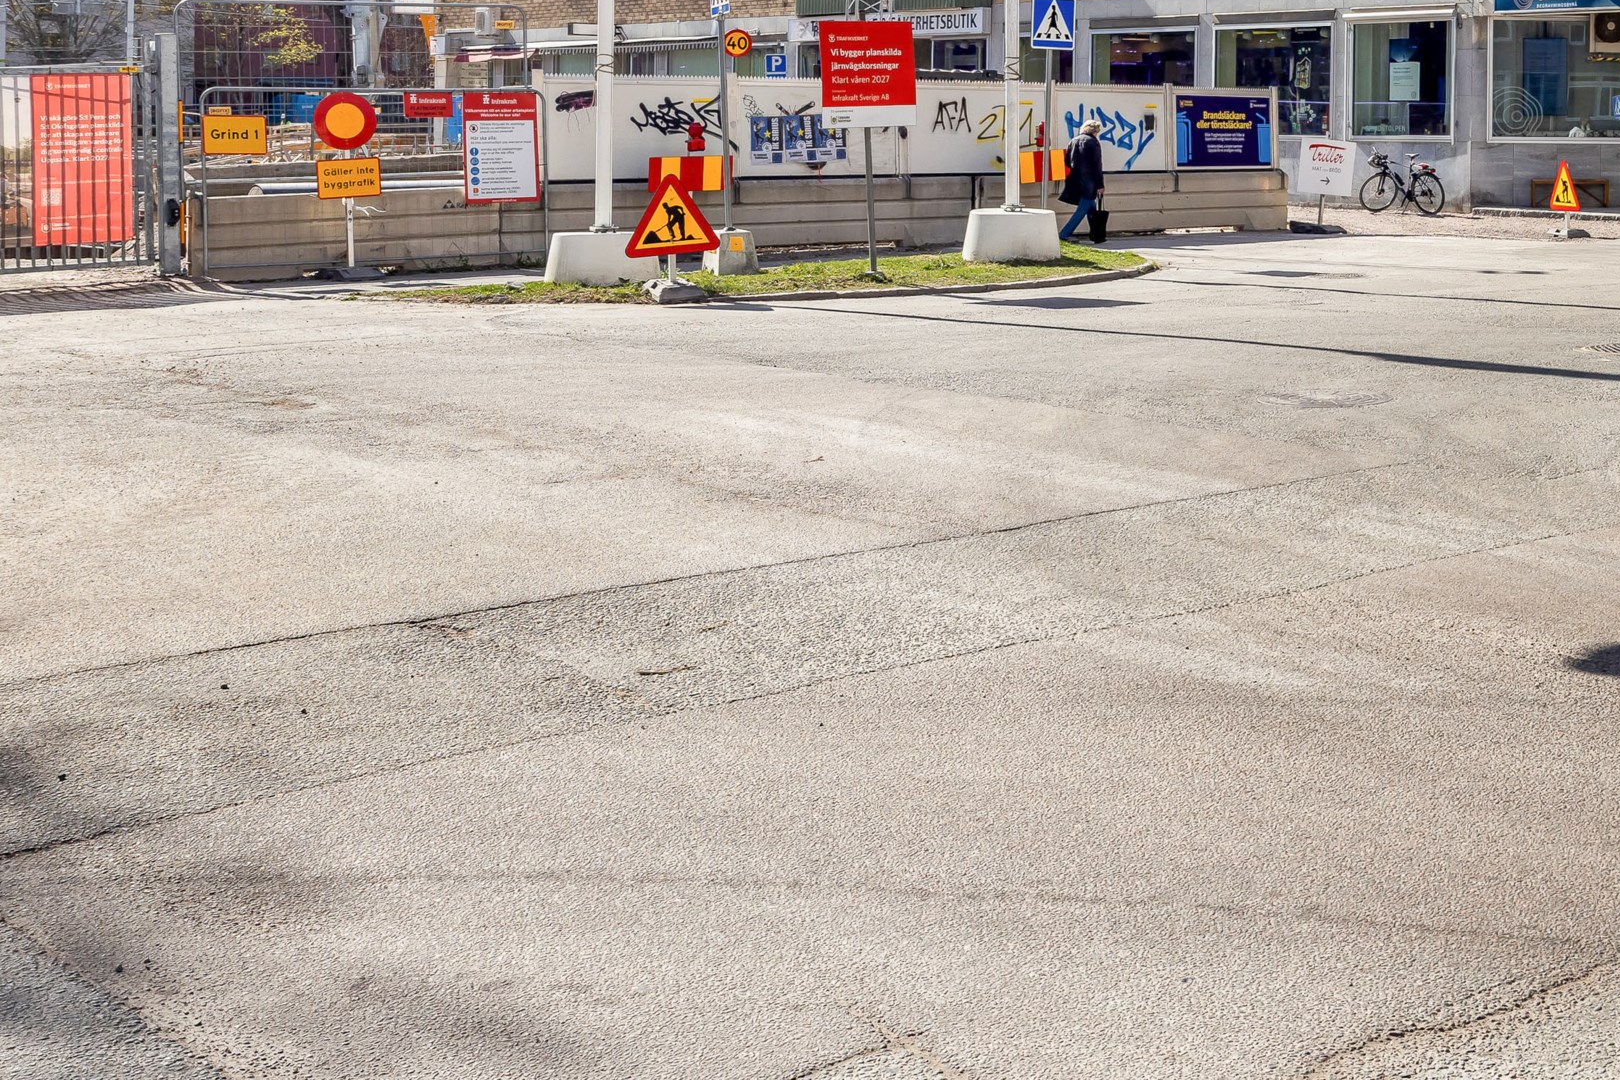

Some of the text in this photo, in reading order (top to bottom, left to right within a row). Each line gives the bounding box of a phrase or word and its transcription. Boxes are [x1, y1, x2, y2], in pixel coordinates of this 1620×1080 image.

[727, 36, 748, 50] 40
[830, 48, 902, 58] Vi bygger planskilda
[772, 56, 783, 72] P
[831, 61, 900, 71] järnvägskorsningar
[831, 75, 890, 84] Klart våren 2027
[832, 94, 859, 102] Infrakraft
[860, 93, 880, 102] Sverige
[932, 96, 972, 133] AFA
[1203, 111, 1246, 120] Brandsläckare
[771, 117, 779, 141] SIRIUS
[803, 116, 812, 139] SIRIUS
[1196, 120, 1253, 129] eller törstsläckare?
[210, 129, 259, 140] Grind 1
[323, 166, 375, 177] Gäller inte
[324, 179, 375, 190] byggtrafik
